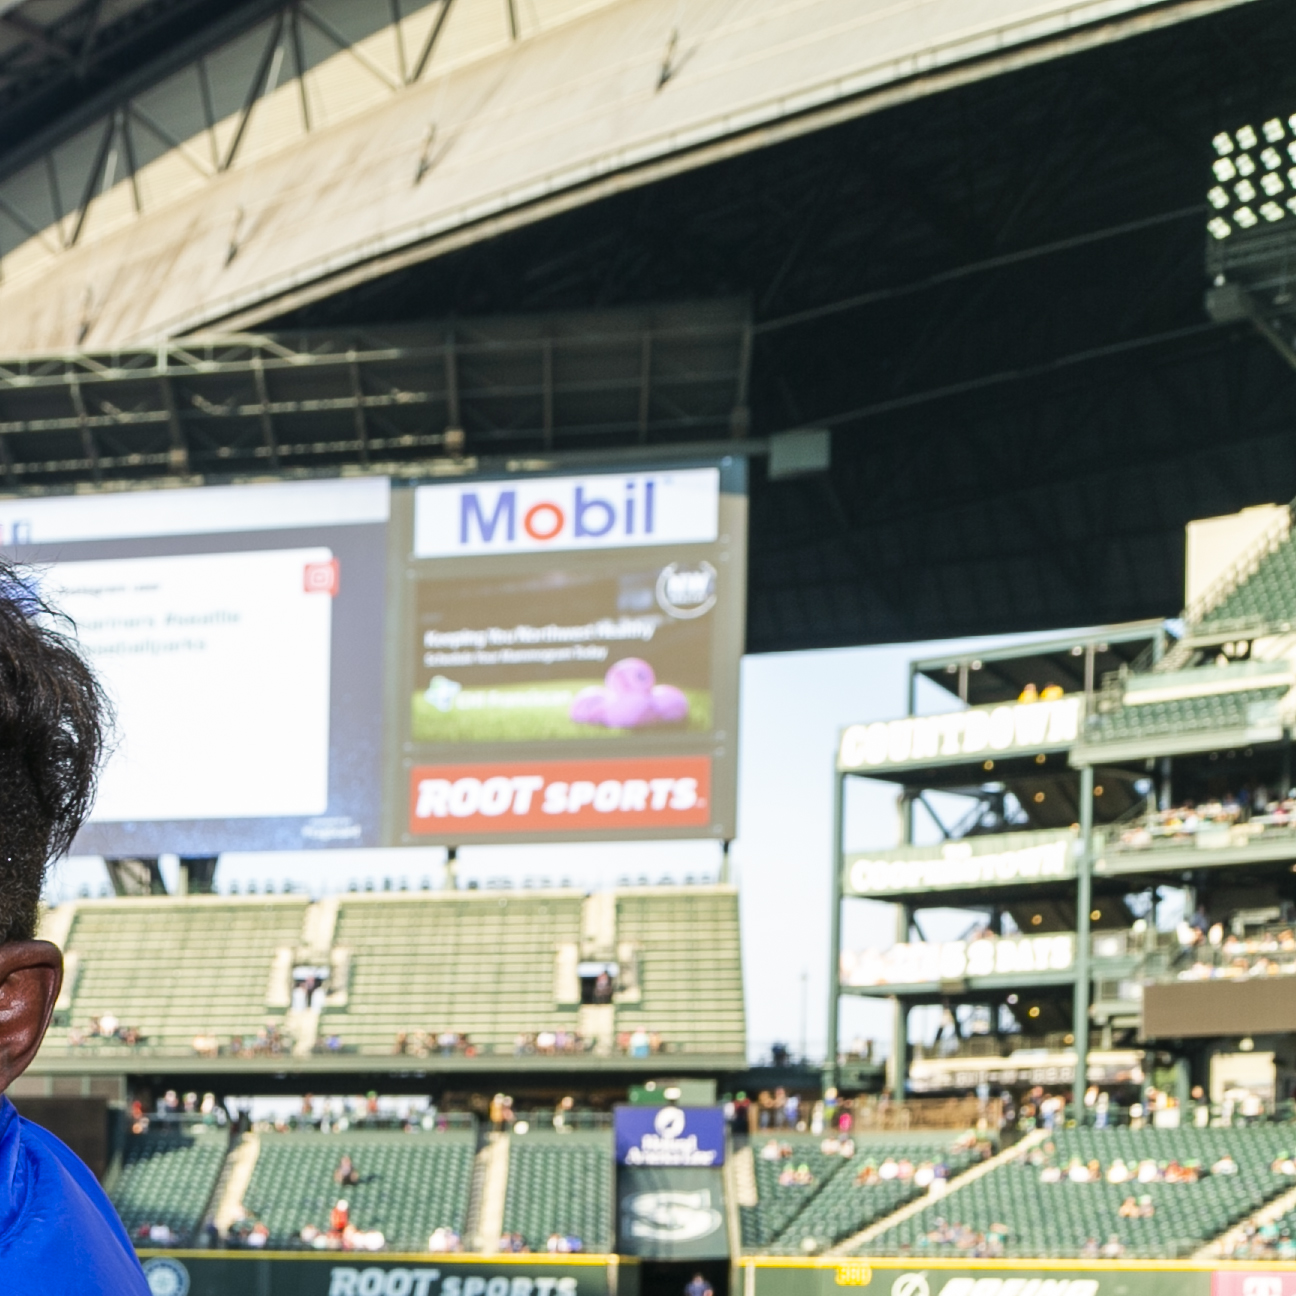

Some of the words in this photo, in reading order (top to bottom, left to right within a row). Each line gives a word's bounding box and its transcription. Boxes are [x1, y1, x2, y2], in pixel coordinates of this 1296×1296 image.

[460, 482, 655, 544] Mobil
[841, 697, 1080, 767] COUNTDOWN
[415, 775, 544, 818] ROOT
[541, 777, 699, 814] SPORTS
[995, 936, 1072, 974] DAYS
